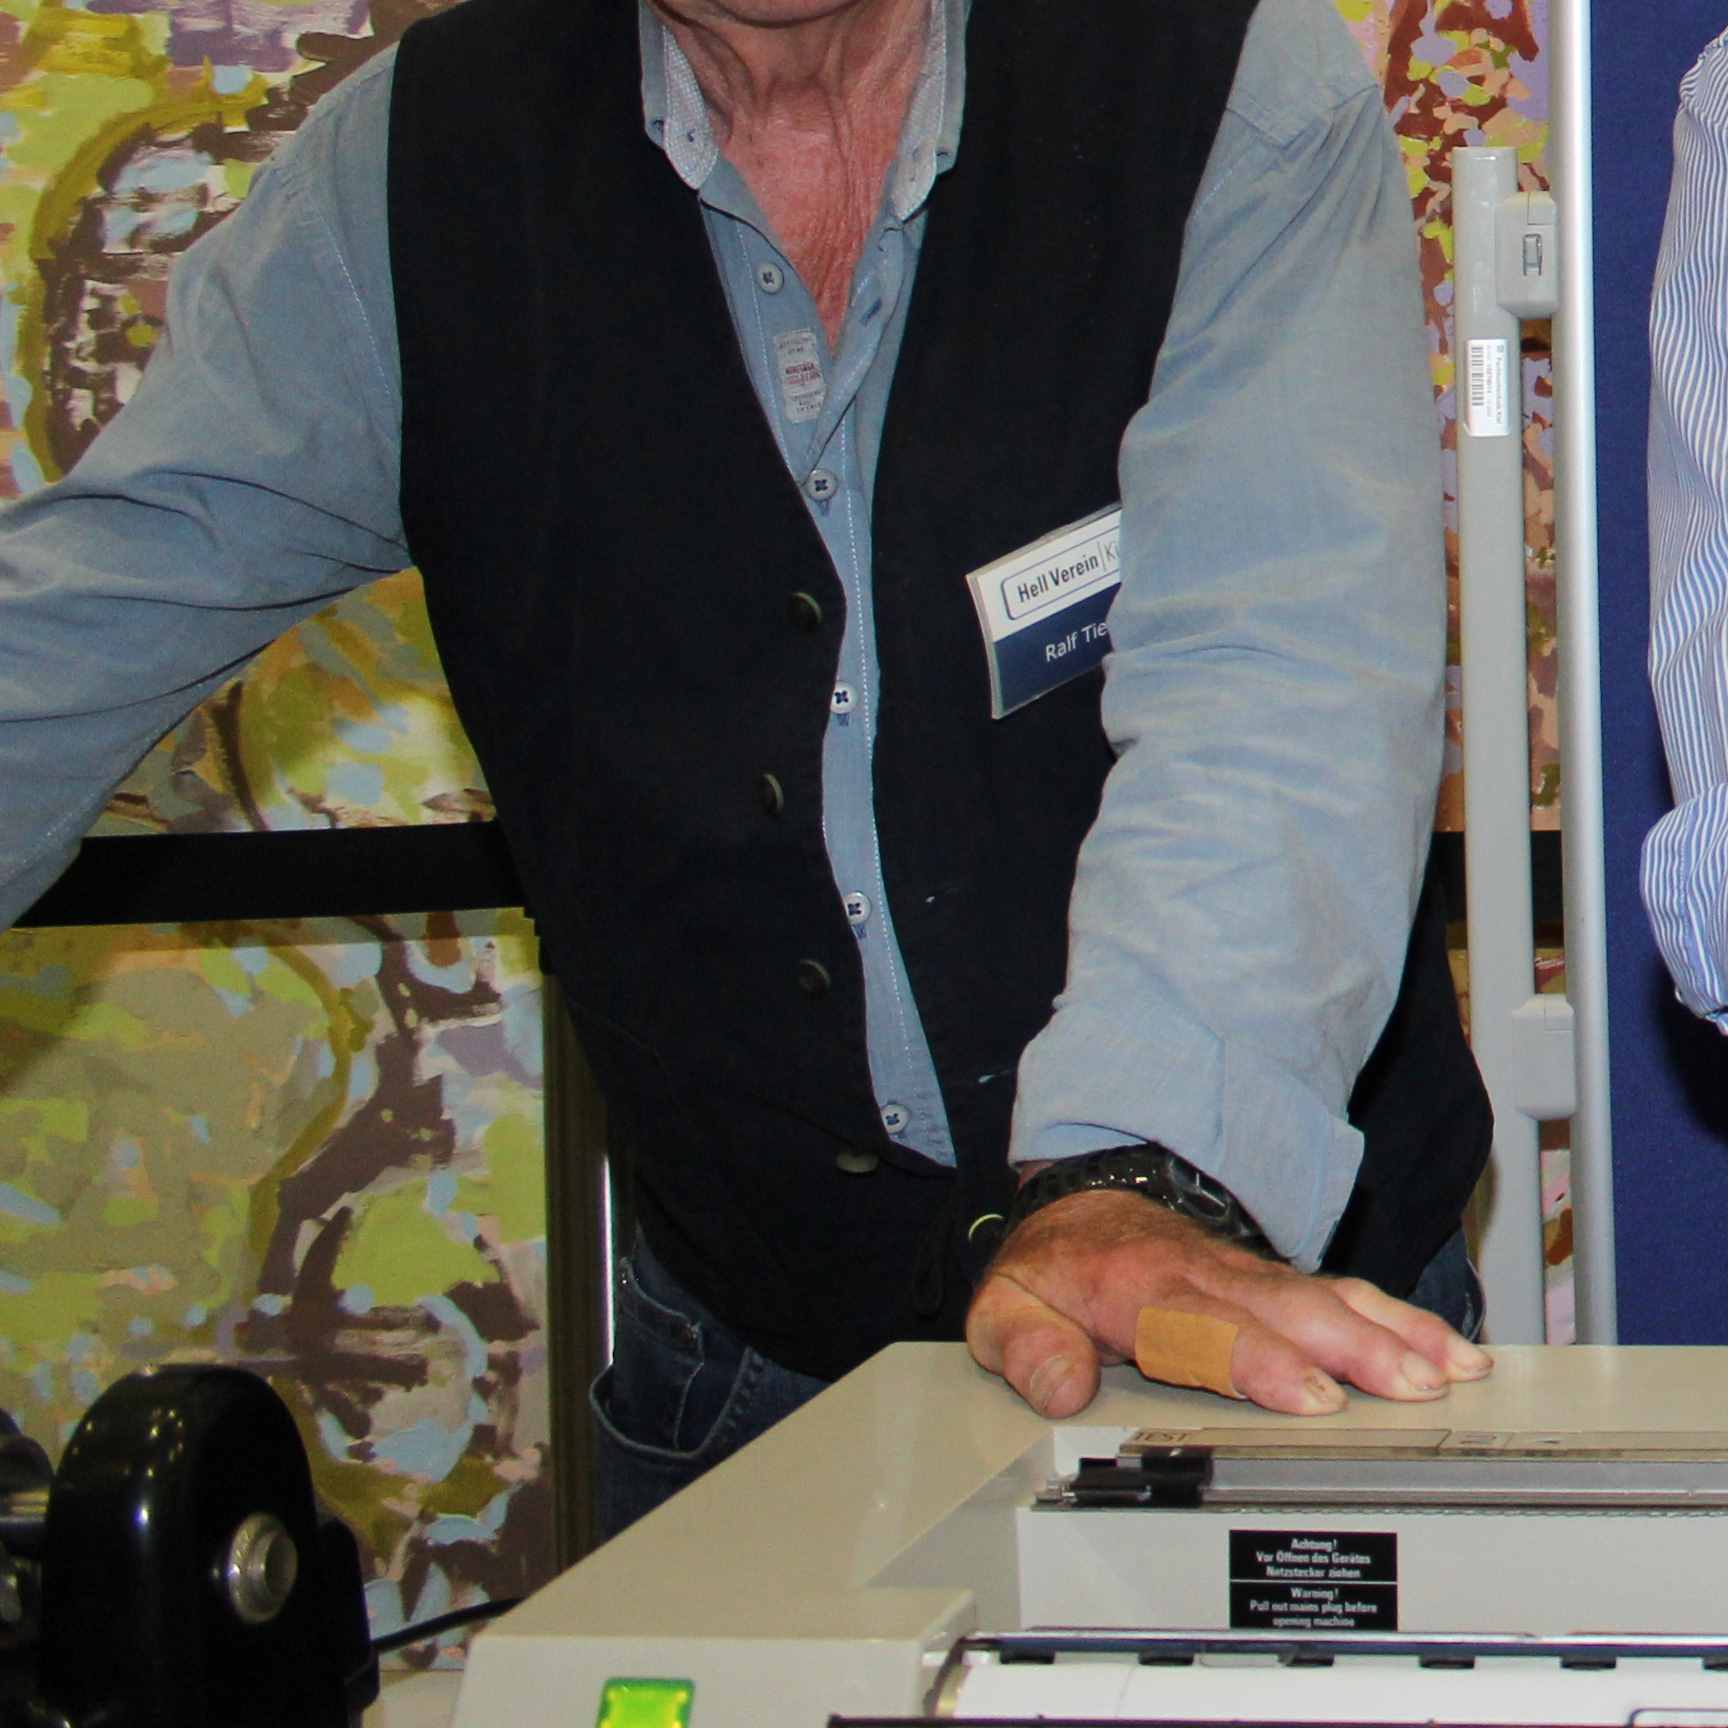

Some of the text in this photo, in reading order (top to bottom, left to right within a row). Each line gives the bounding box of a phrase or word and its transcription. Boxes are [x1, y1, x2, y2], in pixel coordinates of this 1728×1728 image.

[1018, 553, 1099, 603] Hell Verein
[1046, 622, 1108, 662] Ralf Tie
